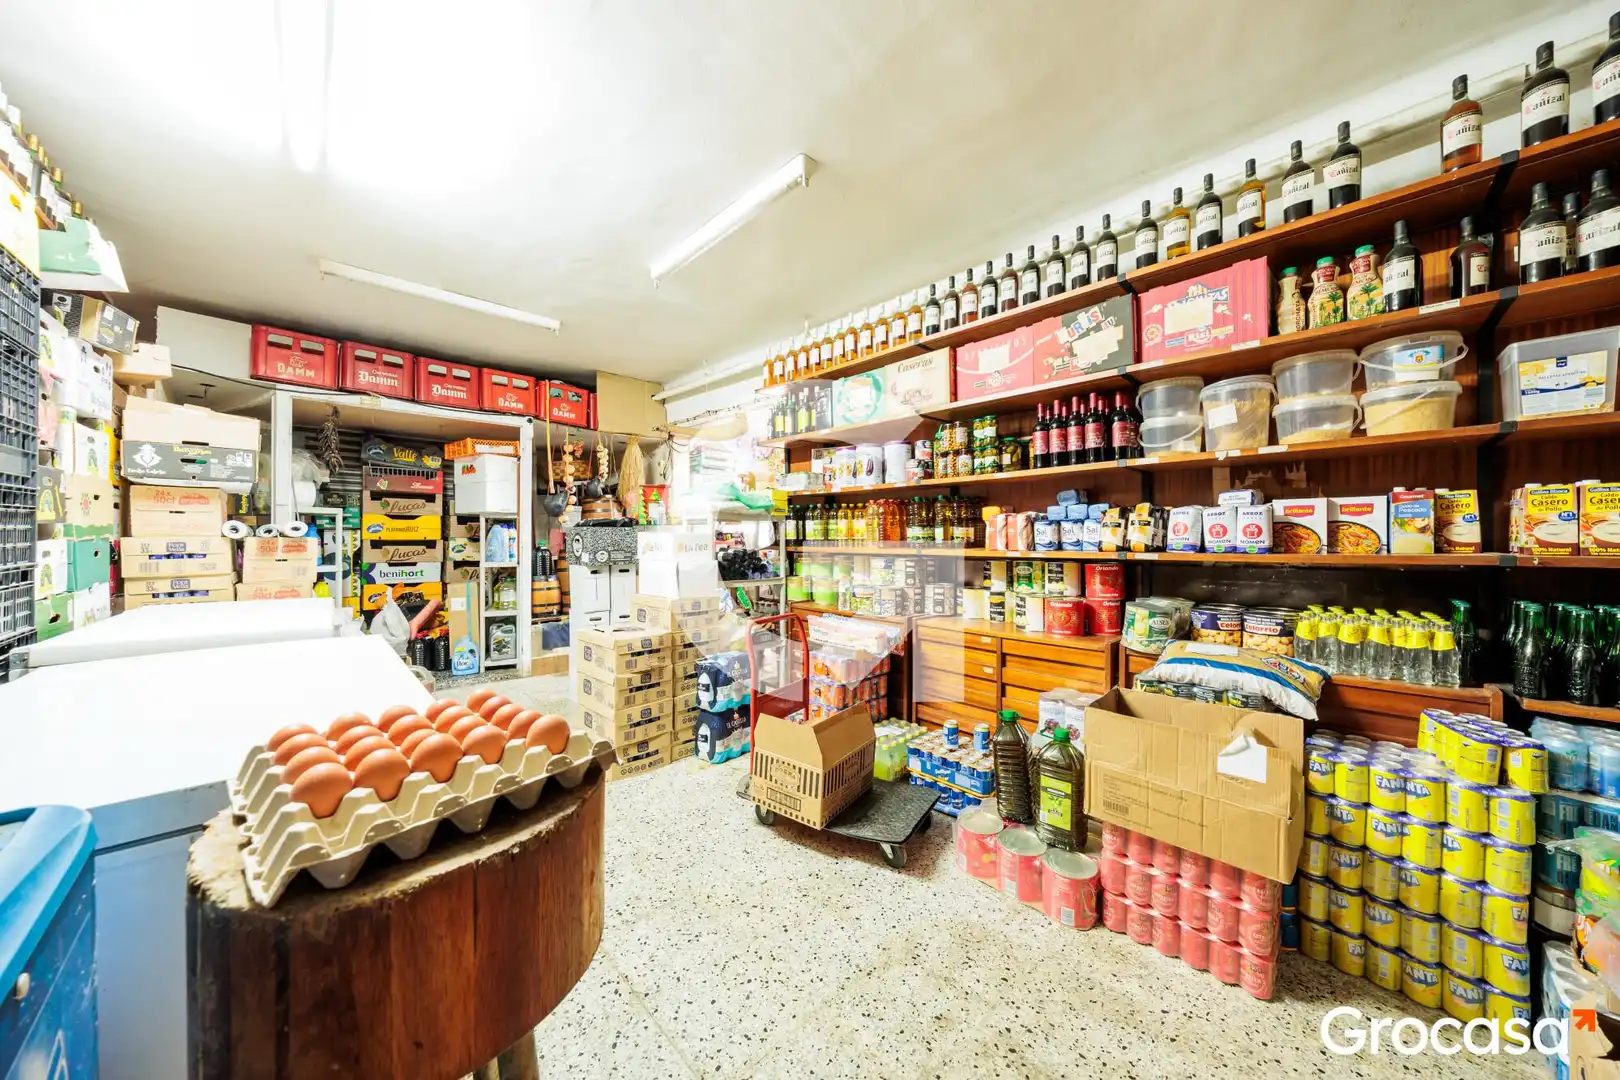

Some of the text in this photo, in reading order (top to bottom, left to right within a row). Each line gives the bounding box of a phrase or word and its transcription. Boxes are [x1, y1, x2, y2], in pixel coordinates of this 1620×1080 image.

[1595, 71, 1620, 90] Cañi
[277, 363, 315, 377] DAMM
[358, 370, 398, 387] Damm
[431, 384, 467, 399] Damm
[498, 398, 524, 409] DAMM
[553, 407, 576, 419] DAMM
[1531, 498, 1569, 507] Casero
[1341, 505, 1373, 514] brillante
[1036, 528, 1047, 536] Sal
[1062, 525, 1074, 534] Sal
[1086, 525, 1098, 534] Sal
[388, 548, 427, 561] Lucas
[380, 569, 424, 578] benihort
